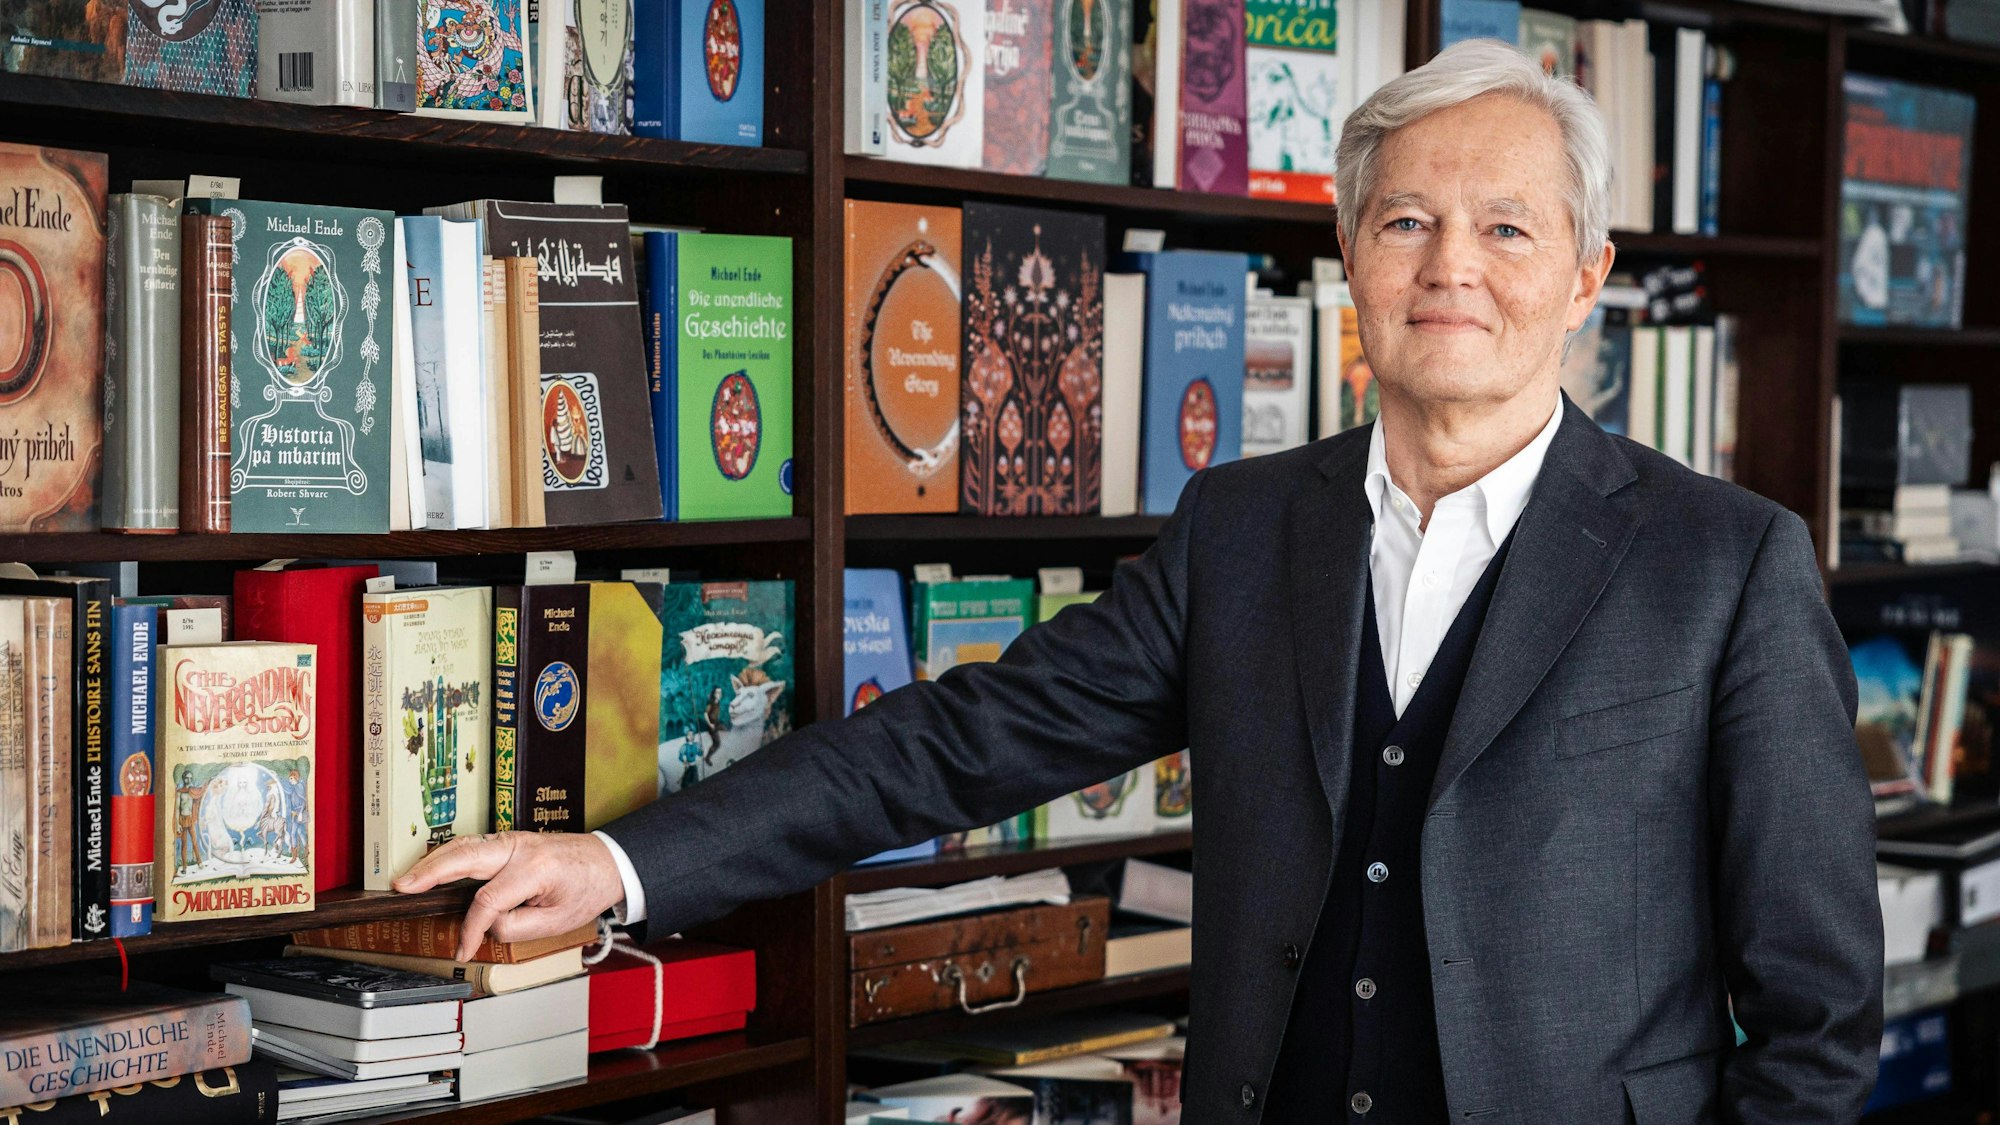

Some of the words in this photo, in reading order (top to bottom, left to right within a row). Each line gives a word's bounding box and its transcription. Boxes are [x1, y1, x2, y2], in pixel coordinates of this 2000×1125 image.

[20, 186, 72, 232] Ende
[141, 213, 178, 227] Michael
[149, 228, 174, 241] Ende
[266, 215, 311, 234] Michael
[314, 218, 344, 236] Ende
[152, 248, 170, 262] Den
[711, 266, 741, 281] Michael
[744, 268, 762, 282] Ende
[688, 289, 711, 307] Die
[714, 292, 783, 309] unendliche
[685, 312, 787, 341] Geschichte
[912, 320, 934, 344] The
[888, 346, 957, 372] Neverending
[904, 372, 939, 398] Story
[260, 423, 334, 447] Historia
[24, 420, 75, 481] příběh
[252, 449, 271, 468] pa
[278, 446, 341, 466] mbarim
[266, 489, 296, 498] Robert
[299, 489, 329, 498] Shvarc
[87, 600, 101, 628] FIN
[369, 614, 378, 623] 05
[544, 607, 576, 619] Michael
[548, 621, 571, 632] Ende
[87, 630, 101, 673] SANS
[133, 621, 148, 663] ENDE
[186, 670, 237, 688] THE
[131, 666, 148, 734] MICHAEL
[174, 658, 312, 740] NEVERENDING
[367, 644, 384, 768] 永远讲不完的故事
[87, 677, 101, 763] L'HISTOIRE
[243, 706, 304, 735] STORY
[87, 765, 102, 806] Ende
[535, 786, 567, 802] Ilma
[533, 805, 570, 825] lõputa
[87, 807, 102, 872] Michael
[172, 887, 261, 916] MICHAEL
[261, 883, 311, 907] ENDE
[5, 1046, 42, 1072] DIE
[47, 1020, 189, 1064] UNENDLICHE
[206, 1023, 214, 1054] Ende
[216, 1011, 227, 1060] Michael
[28, 1050, 169, 1094] GESCHICHTE
